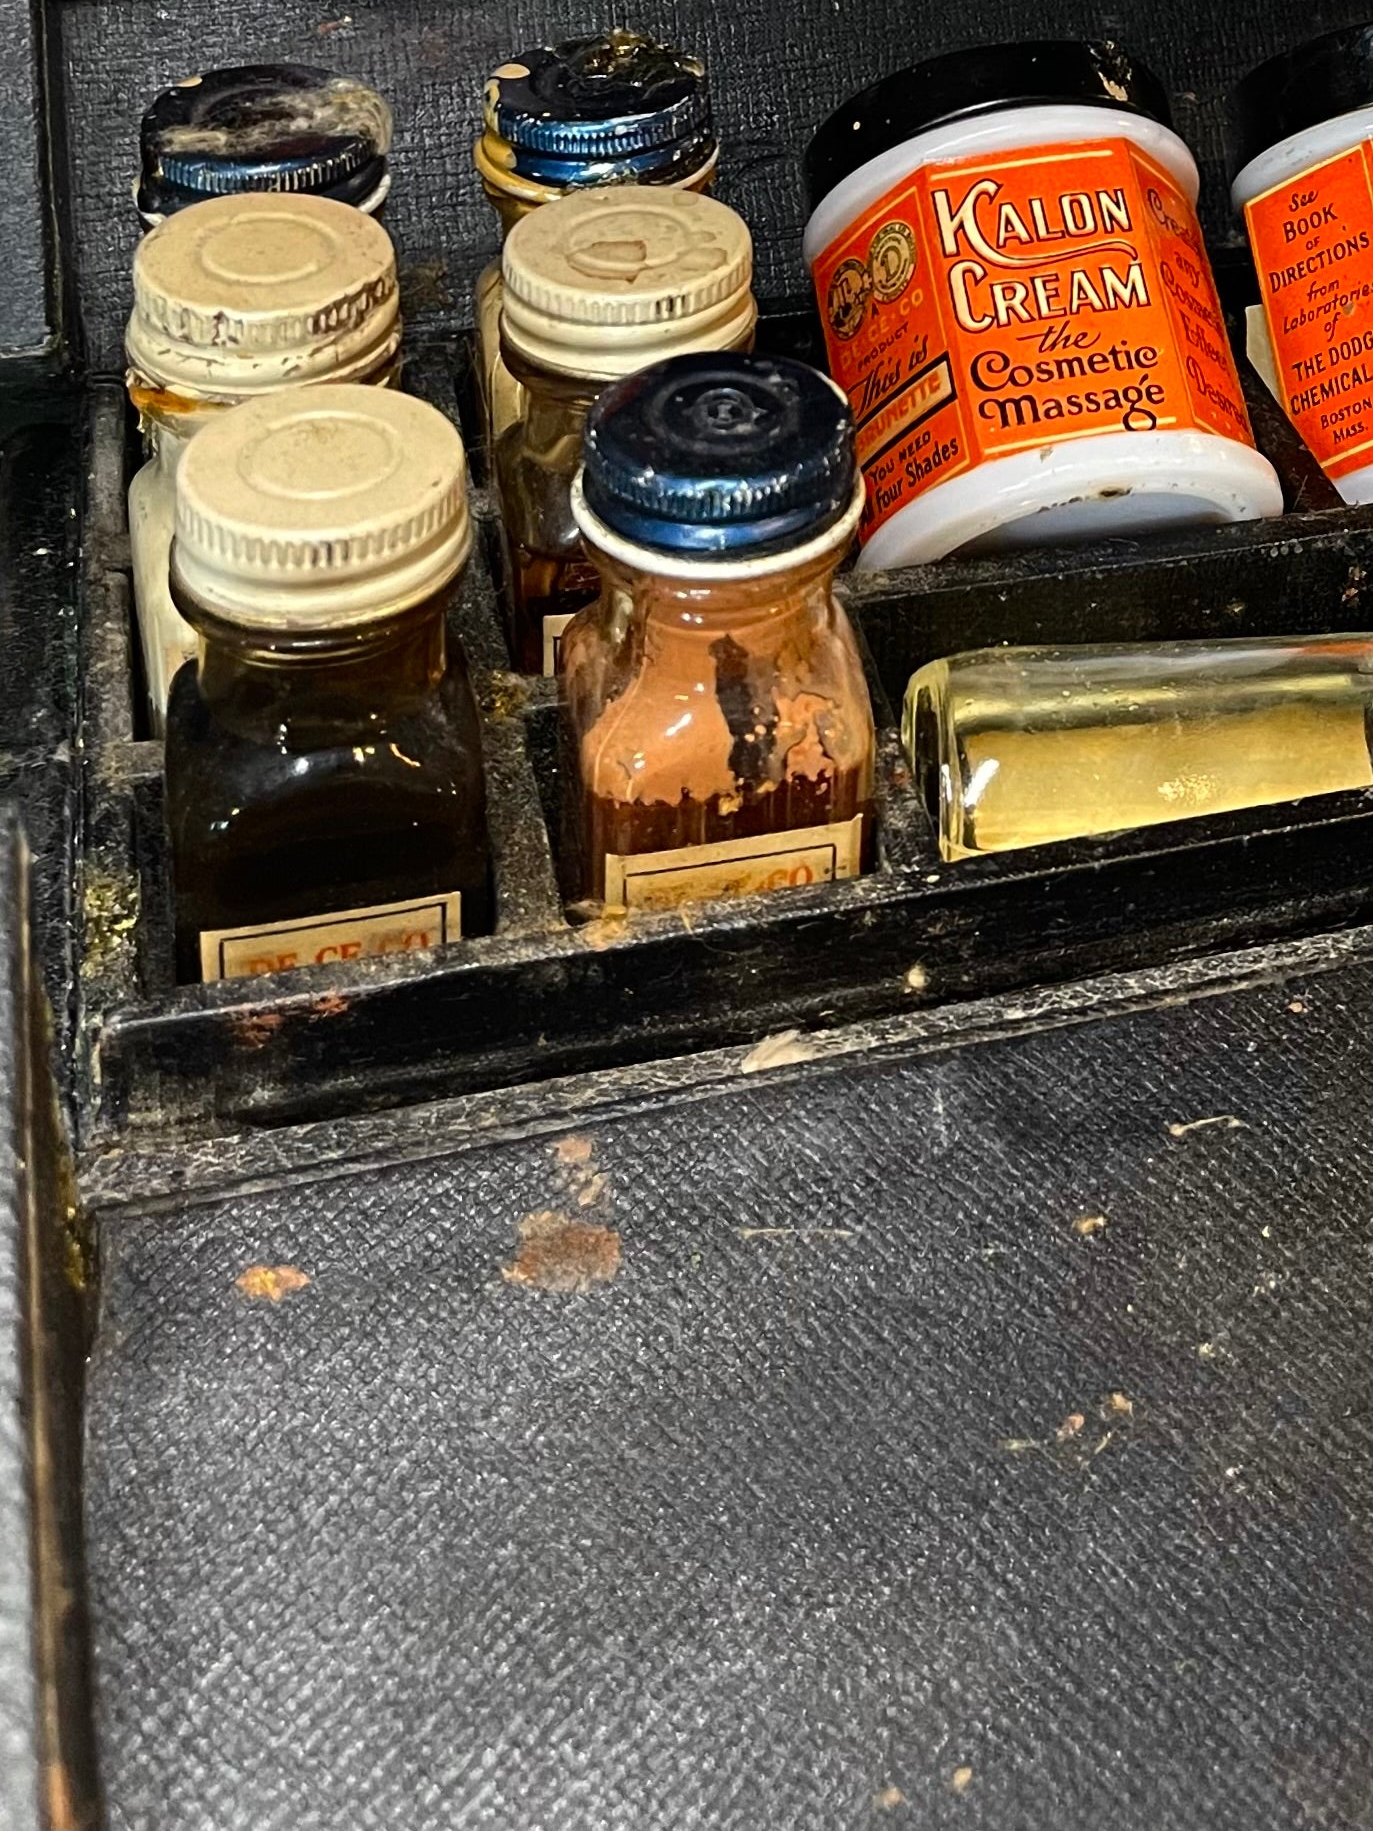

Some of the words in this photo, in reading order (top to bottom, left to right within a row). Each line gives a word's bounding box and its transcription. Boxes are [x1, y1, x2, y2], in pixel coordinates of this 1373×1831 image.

[1289, 190, 1319, 213] See
[1282, 203, 1339, 244] BOOK
[1268, 231, 1371, 294] DIRECTIONS
[947, 258, 1152, 334] CREAM
[1306, 278, 1341, 303] from
[1016, 320, 1102, 354] the
[1323, 311, 1341, 343] of
[970, 338, 1160, 393] Cosmetic
[1292, 359, 1326, 383] THE
[978, 374, 1166, 431] Massage
[1320, 396, 1373, 431] BOSTON
[869, 459, 895, 487] YOU
[898, 430, 931, 463] NEED
[905, 437, 960, 489] Shades
